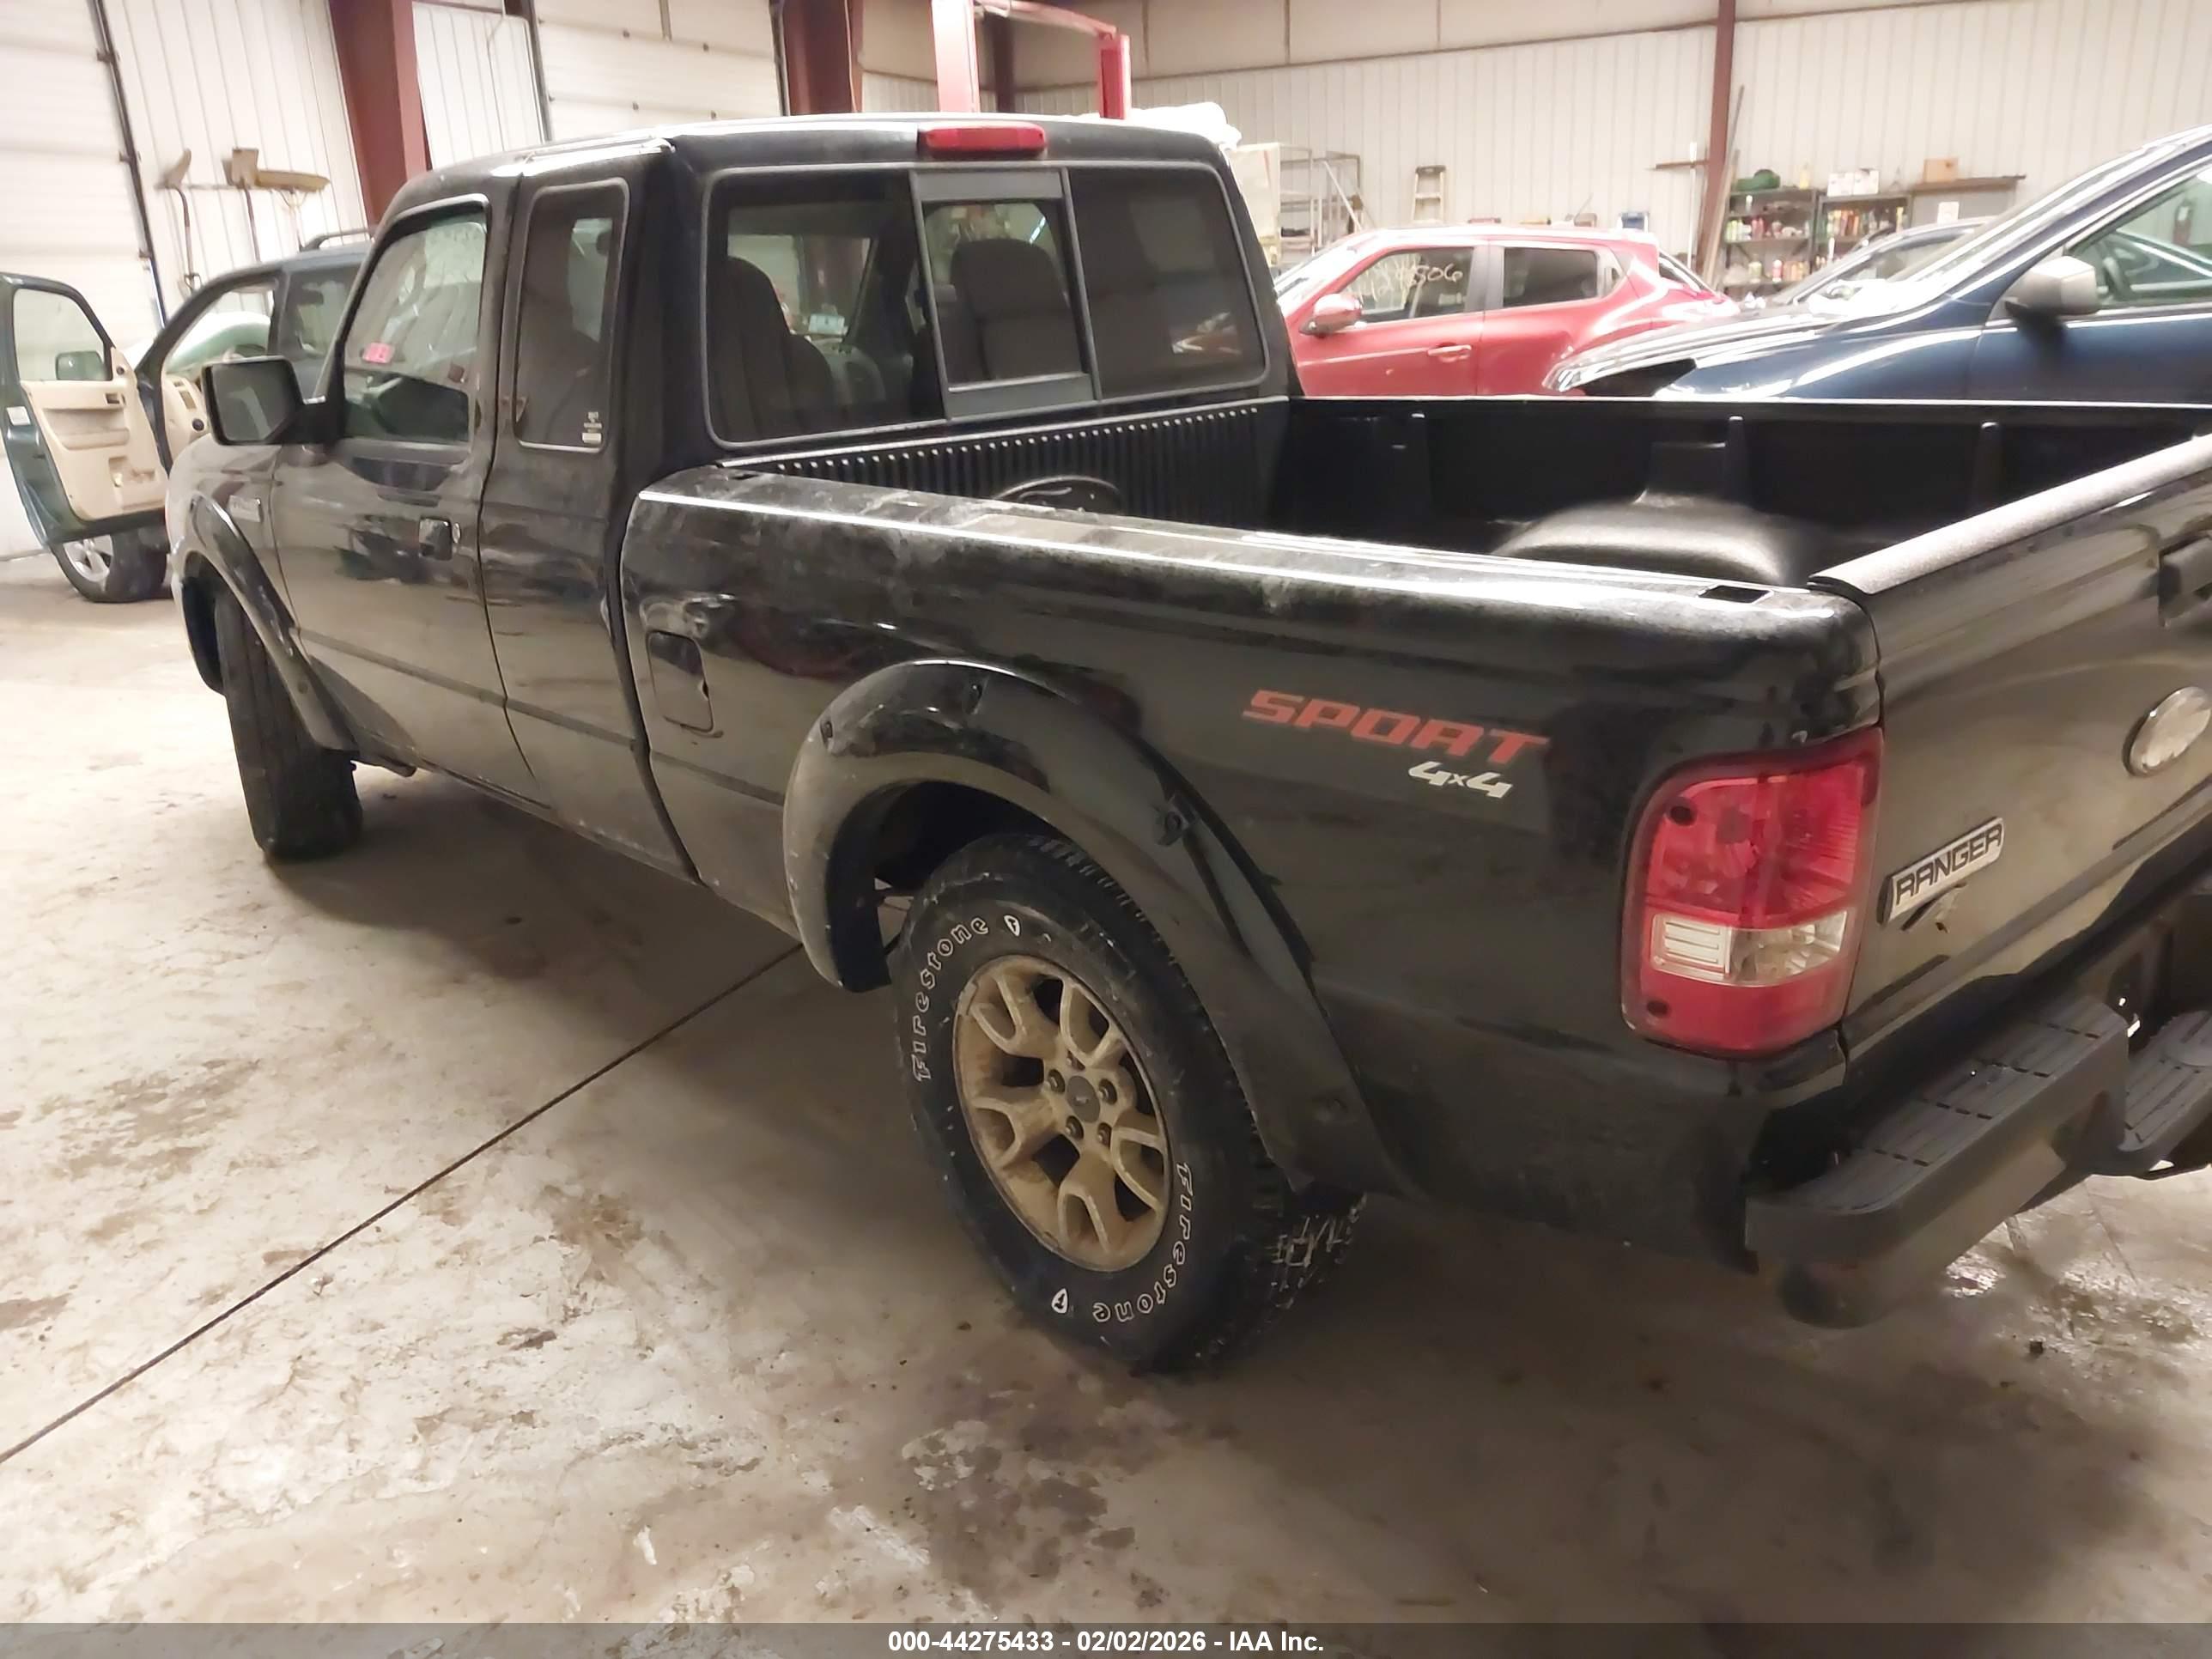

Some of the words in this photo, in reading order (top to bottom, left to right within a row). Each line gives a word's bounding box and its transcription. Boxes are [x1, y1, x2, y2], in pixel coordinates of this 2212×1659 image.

[1243, 690, 1551, 764] SPORT
[1408, 761, 1512, 799] 4x4
[1895, 823, 2003, 906] RANGER
[911, 917, 989, 1082] Firestone
[1092, 1162, 1194, 1322] Firestone
